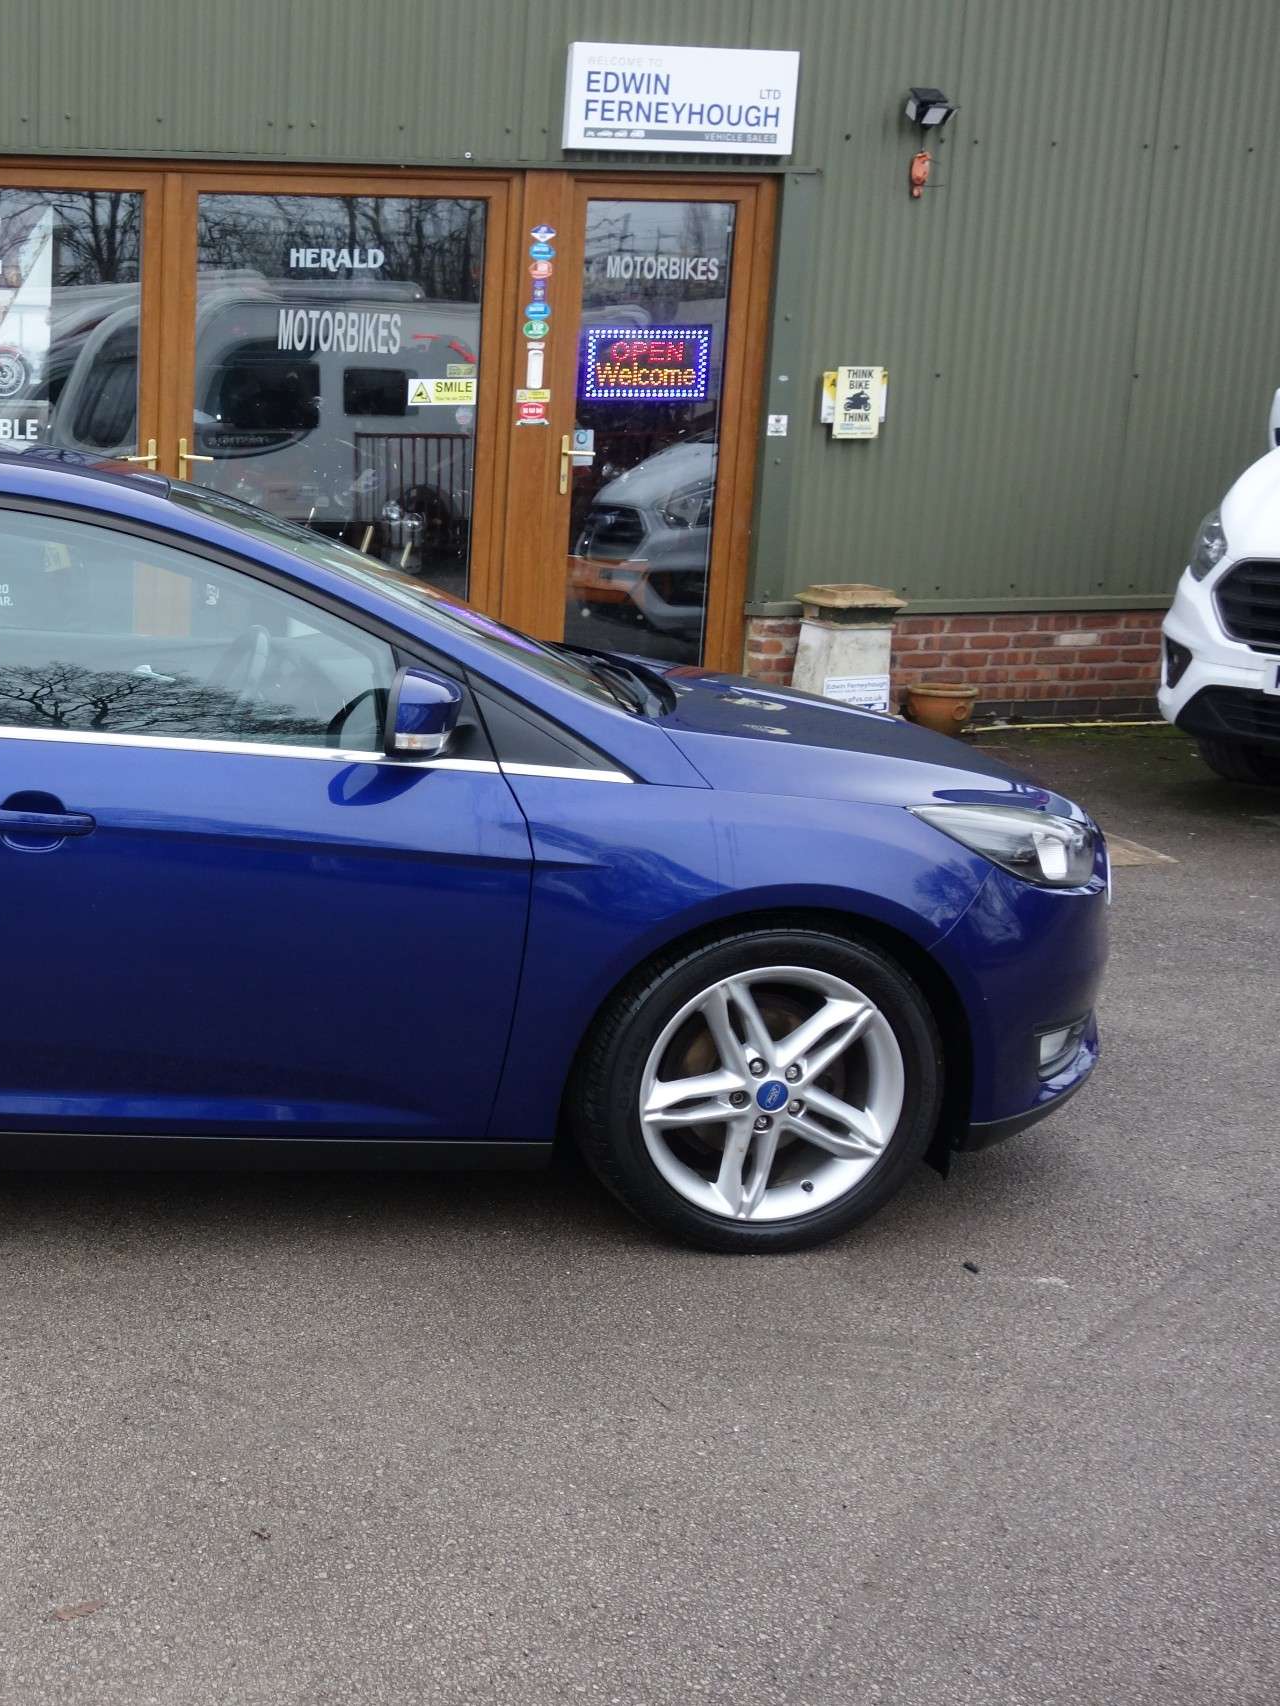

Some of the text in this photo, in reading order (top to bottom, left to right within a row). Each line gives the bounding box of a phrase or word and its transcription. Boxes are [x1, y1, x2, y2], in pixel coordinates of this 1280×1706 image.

[586, 70, 671, 95] EDWIN
[759, 89, 781, 100] LTD
[584, 99, 780, 128] FERNEYHOUGH
[704, 132, 777, 144] VEHICLE SALES
[289, 248, 385, 272] HERALD
[607, 254, 719, 281] MOTORBIKES
[277, 308, 402, 354] MOTORBIKES
[610, 341, 684, 361] OPEN
[595, 362, 697, 387] Welcome
[847, 369, 874, 379] THINK
[435, 381, 473, 393] SMILE
[849, 380, 870, 390] BIKE
[843, 412, 870, 422] THINK
